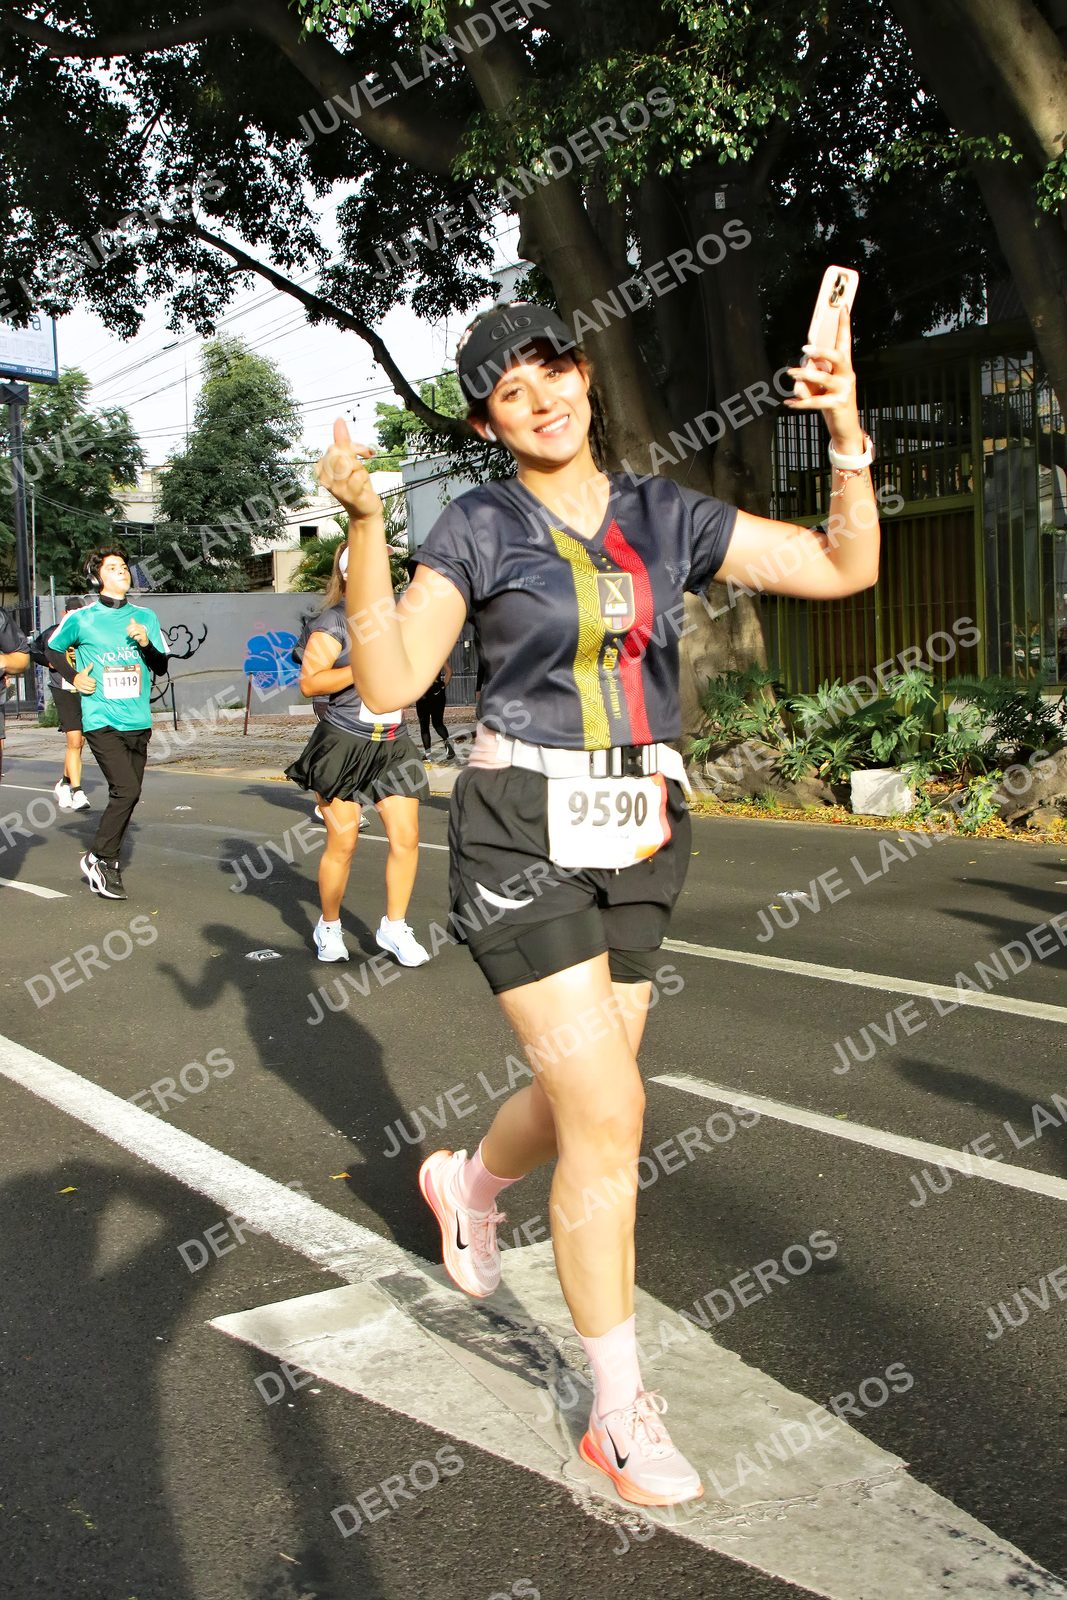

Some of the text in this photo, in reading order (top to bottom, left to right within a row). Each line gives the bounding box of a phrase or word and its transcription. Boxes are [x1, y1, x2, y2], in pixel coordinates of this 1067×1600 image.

[490, 313, 532, 341] alo
[106, 675, 138, 688] 11419
[567, 790, 648, 827] 9590
